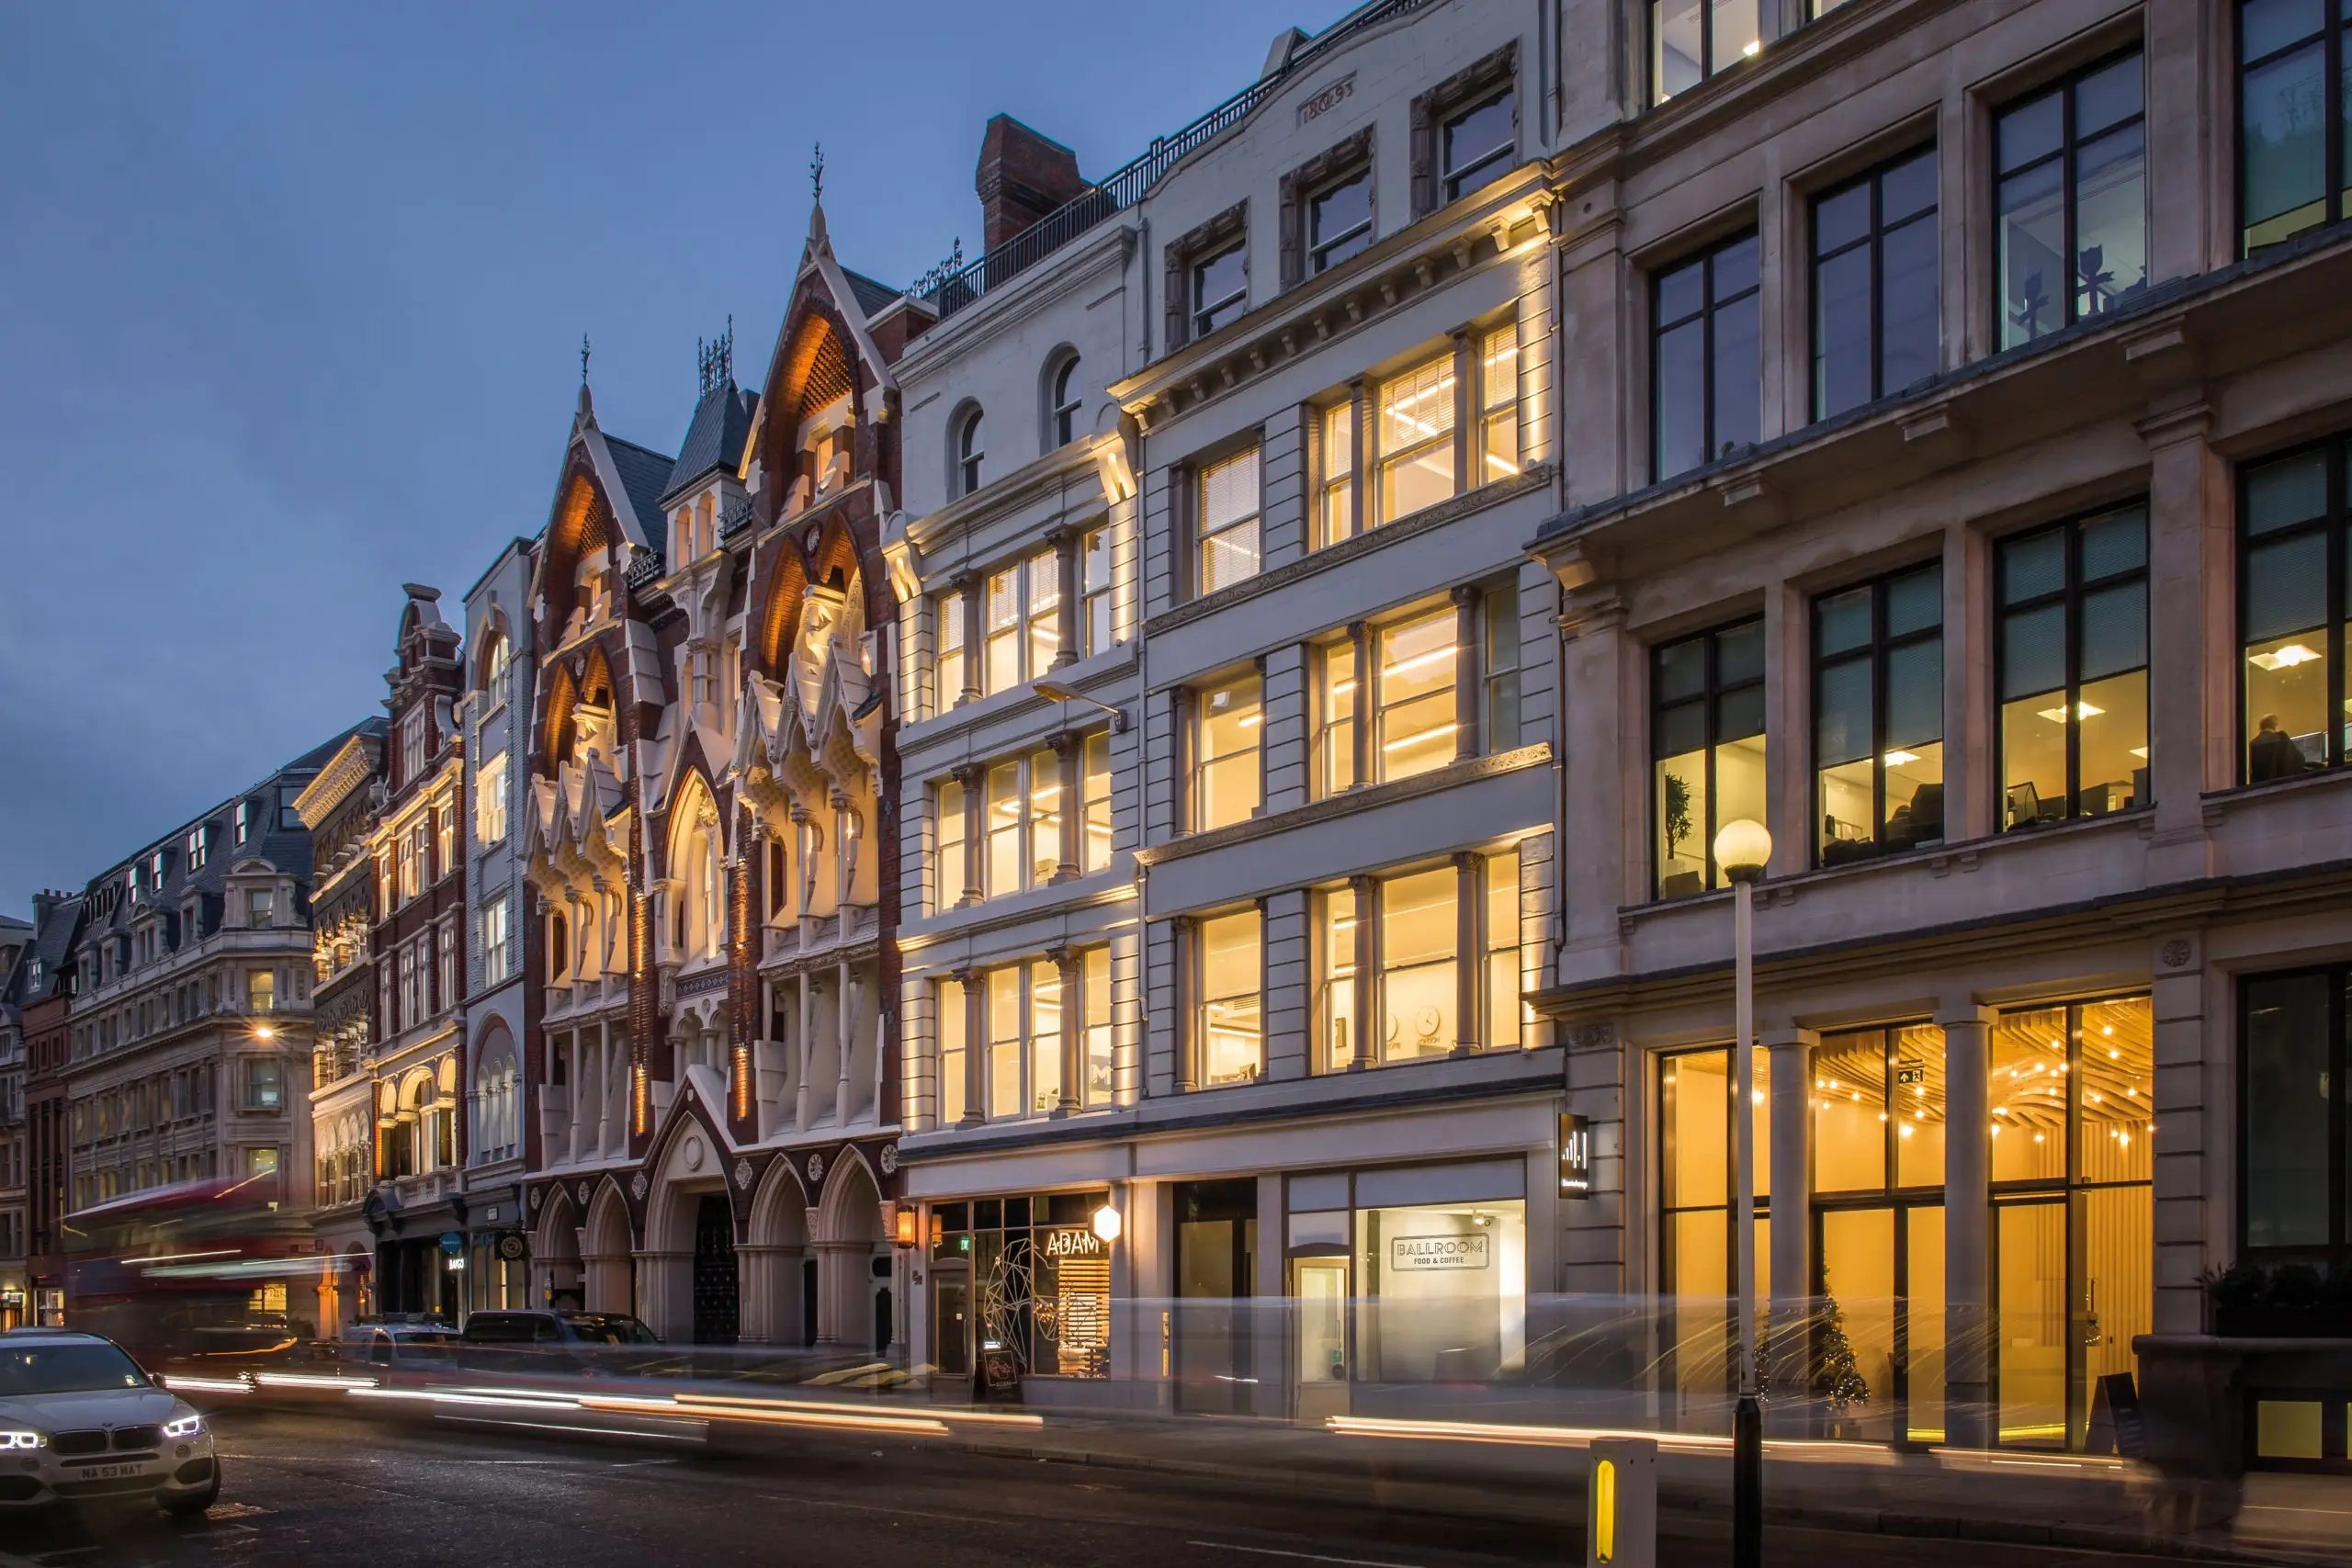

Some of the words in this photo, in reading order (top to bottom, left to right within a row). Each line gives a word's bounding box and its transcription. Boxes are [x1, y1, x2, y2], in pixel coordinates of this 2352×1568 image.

[1046, 1229, 1099, 1257] ADAM
[1396, 1240, 1483, 1257] BALLROOM
[1440, 1256, 1464, 1264] COFFEE
[101, 1467, 118, 1477] 53
